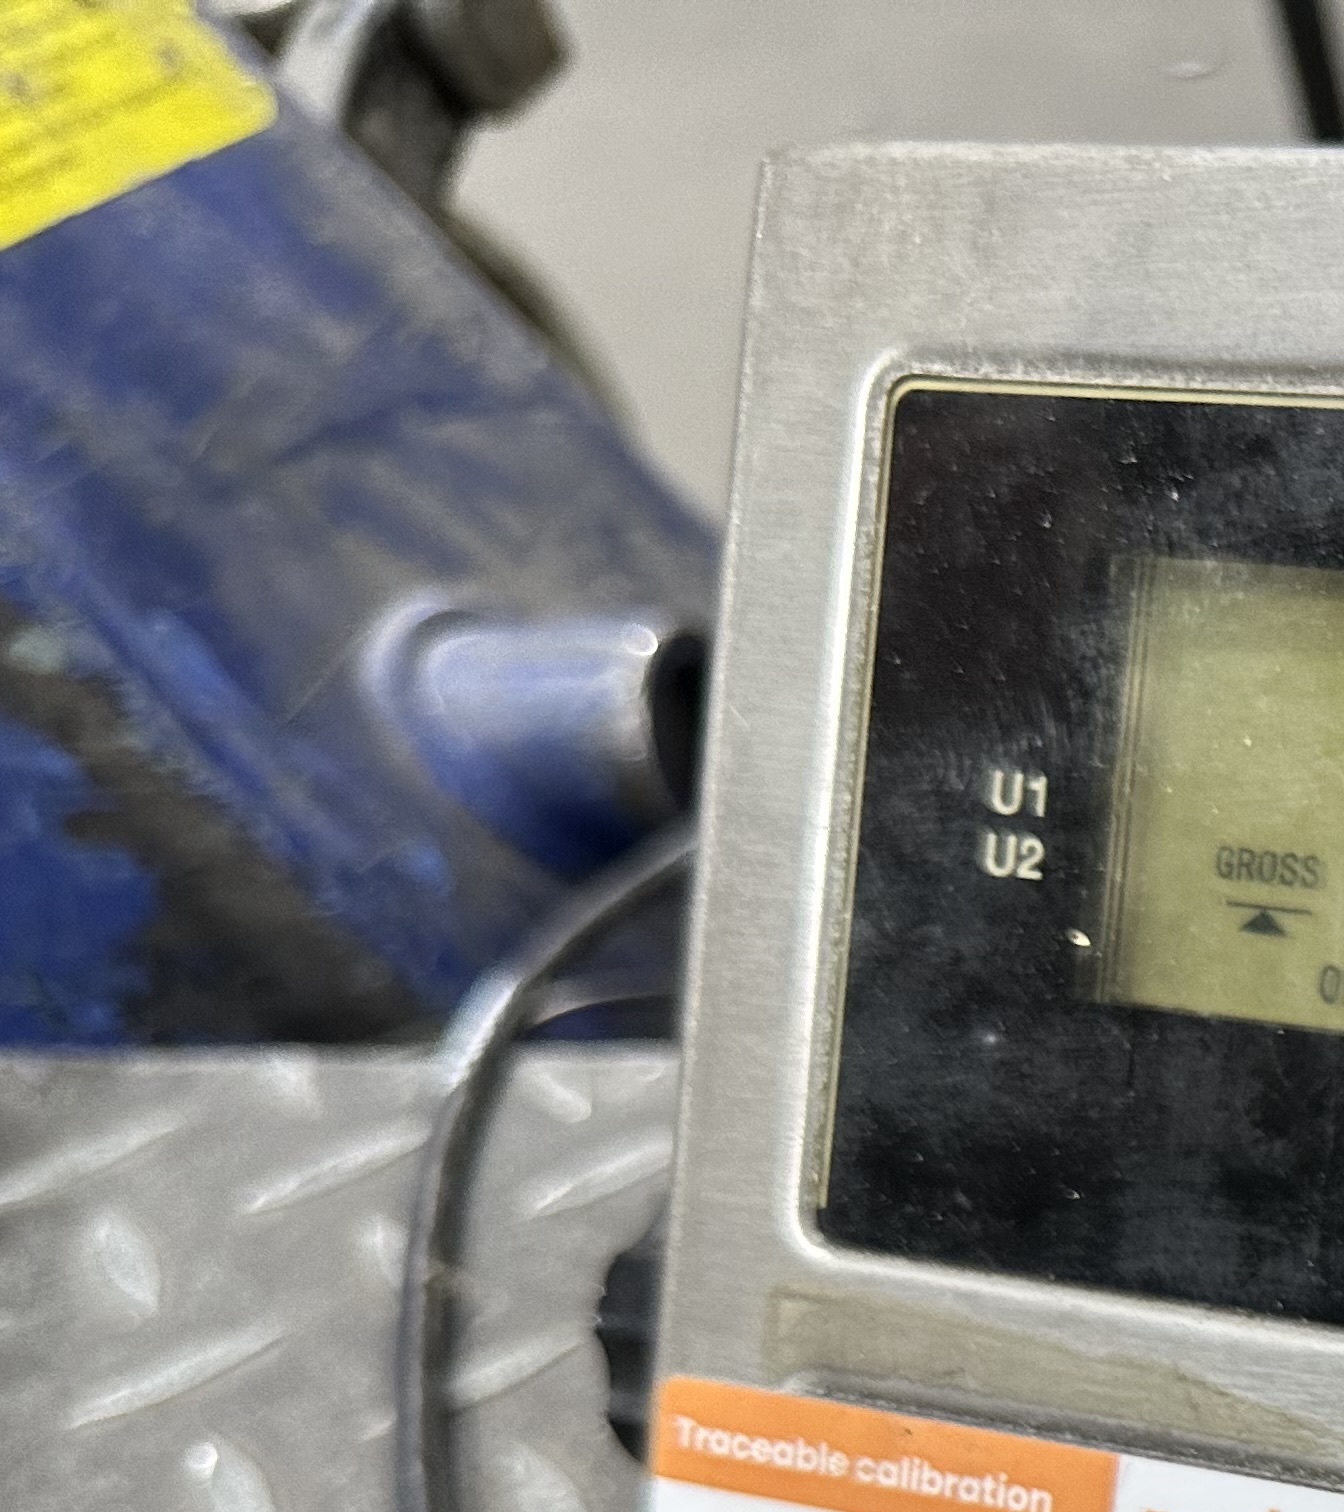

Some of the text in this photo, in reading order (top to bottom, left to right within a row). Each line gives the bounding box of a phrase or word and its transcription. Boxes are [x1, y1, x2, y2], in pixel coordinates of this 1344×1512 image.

[988, 769, 1048, 819] U1
[983, 833, 1044, 882] U2
[1215, 845, 1321, 889] GROSS
[674, 1415, 850, 1478] Traceable
